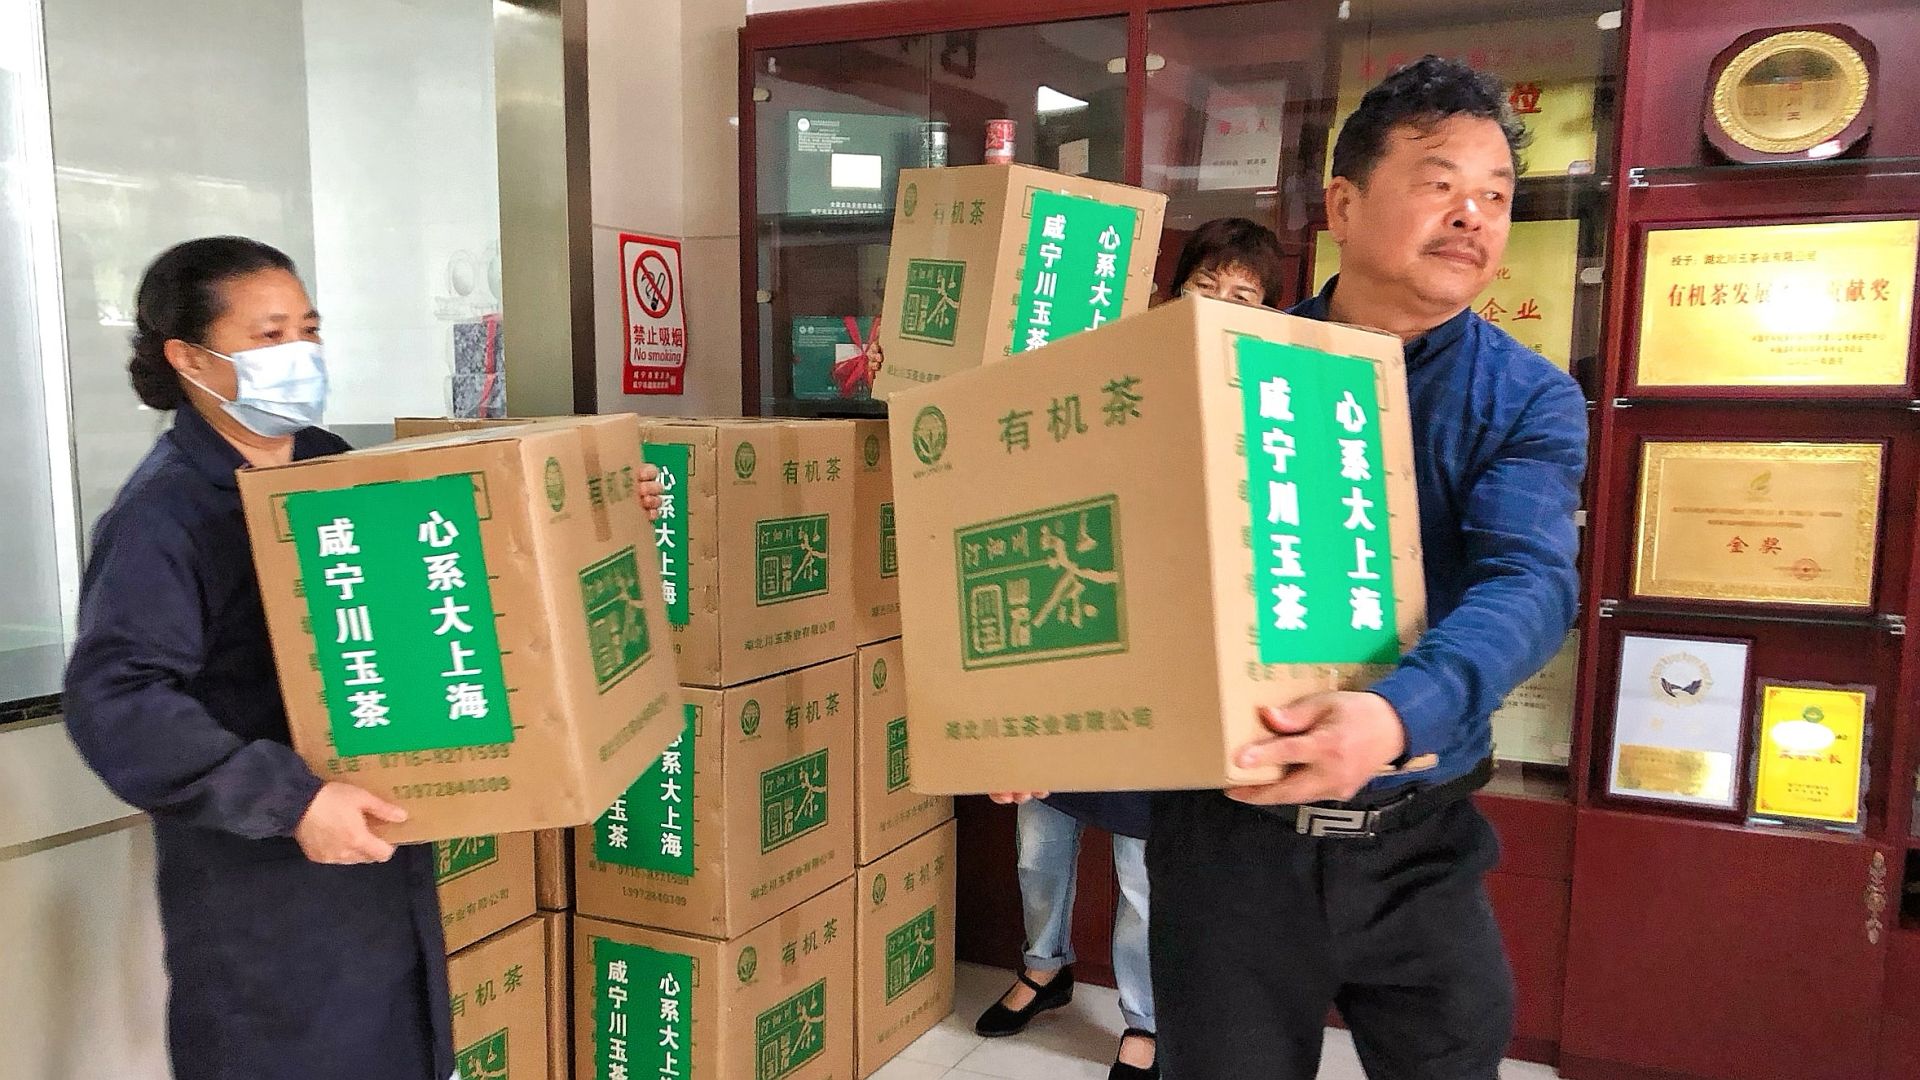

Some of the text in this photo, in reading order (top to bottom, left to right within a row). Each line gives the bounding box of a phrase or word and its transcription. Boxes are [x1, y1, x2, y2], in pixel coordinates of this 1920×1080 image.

[1024, 213, 1067, 353] 咸宁川玉茶
[632, 324, 683, 348] 禁止吸烟
[1477, 297, 1542, 323] 企业
[633, 347, 682, 365] No smoking
[997, 373, 1144, 456] 有机茶
[782, 457, 842, 485] 有机茶
[1258, 375, 1309, 631] 咸宁川玉茶
[1335, 390, 1384, 631] 心系大上海
[1726, 535, 1783, 555] 金奖
[317, 517, 392, 729] 咸宁川玉茶
[417, 510, 490, 721] 心系大上海
[785, 691, 840, 731] 有机茶
[903, 854, 946, 893] 有机茶
[781, 917, 839, 969] 有机茶
[450, 963, 524, 1018] 有机茶
[658, 972, 681, 1080] 心系大上
